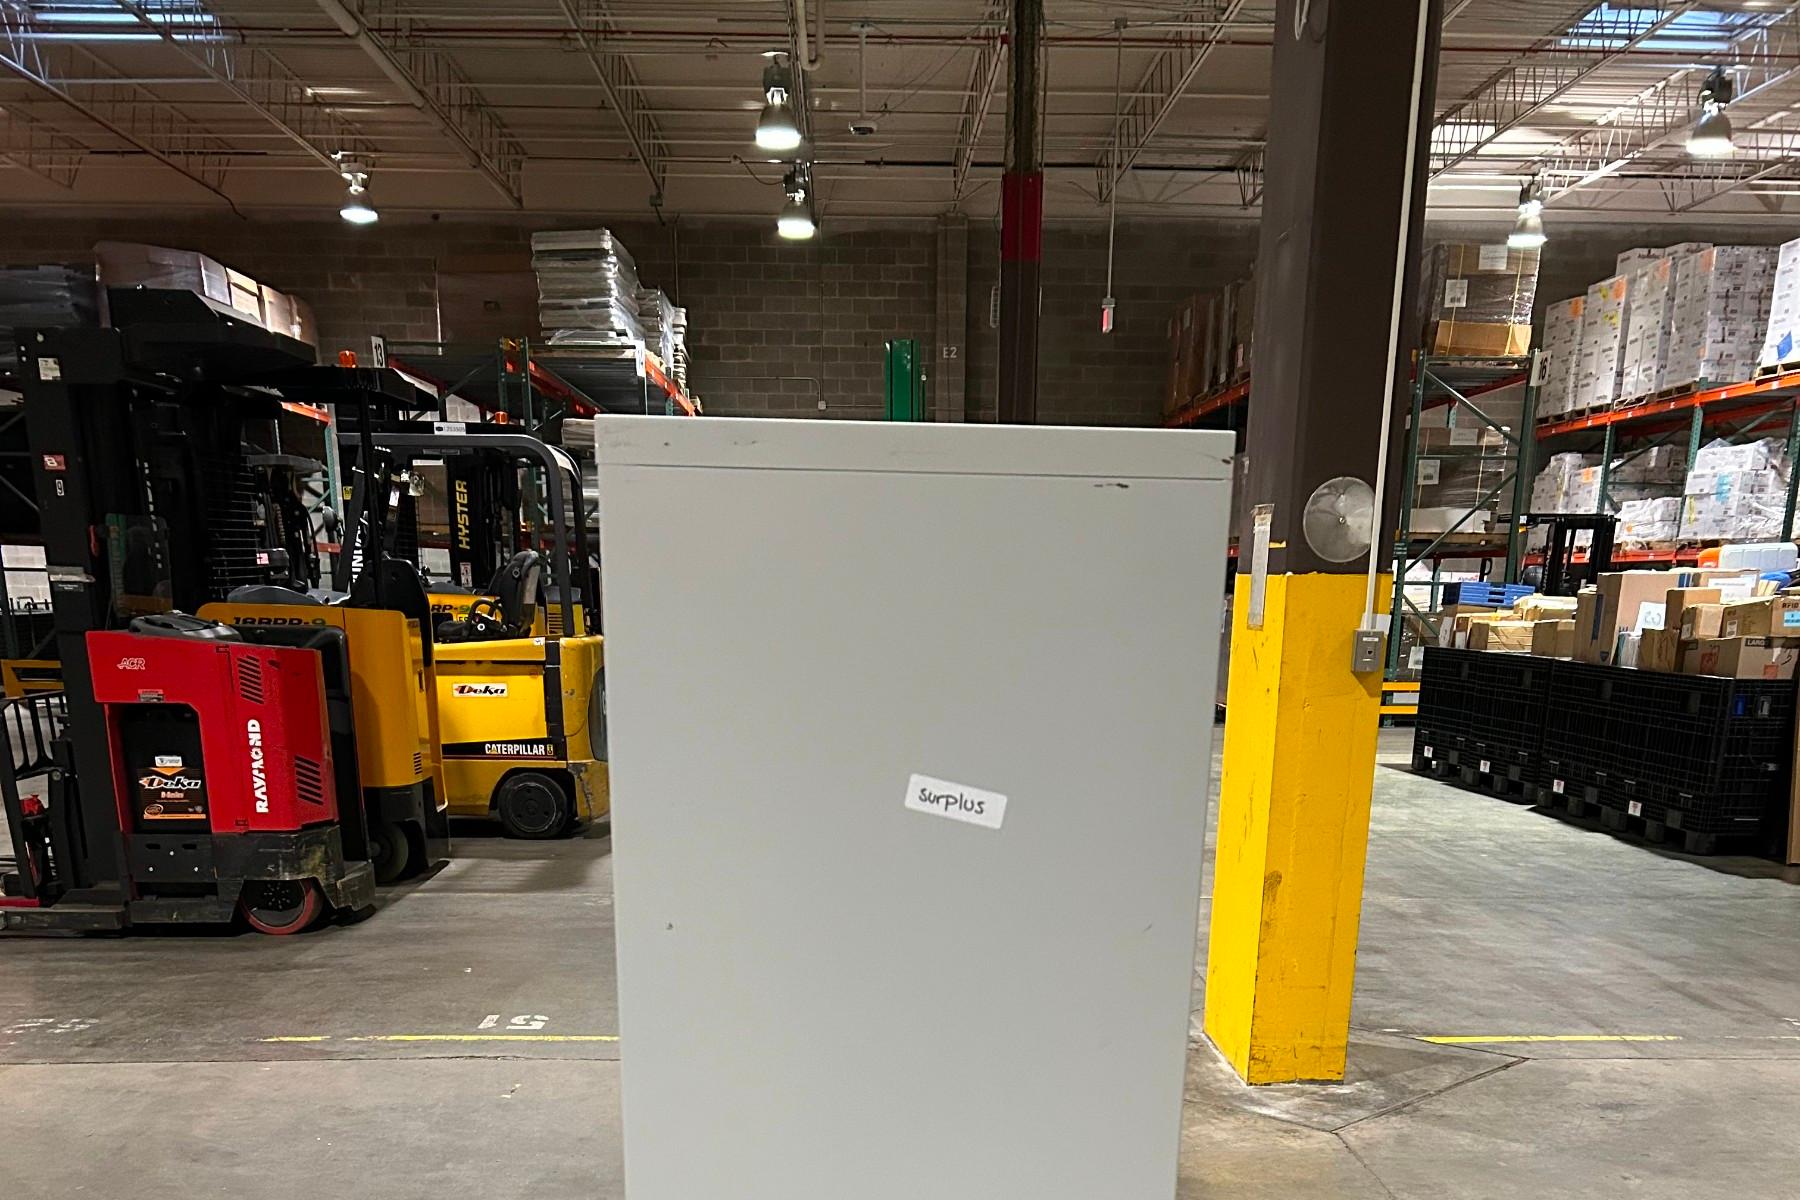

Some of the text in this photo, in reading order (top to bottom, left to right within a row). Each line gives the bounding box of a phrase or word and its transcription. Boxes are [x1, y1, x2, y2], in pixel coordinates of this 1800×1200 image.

[374, 343, 384, 367] 13
[943, 346, 957, 358] E2
[1539, 357, 1548, 380] 16
[456, 480, 470, 550] HYSTER
[117, 657, 146, 670] ACR
[455, 684, 506, 695] Deka
[485, 743, 545, 756] CATERPILLAR
[139, 775, 201, 789] Deka
